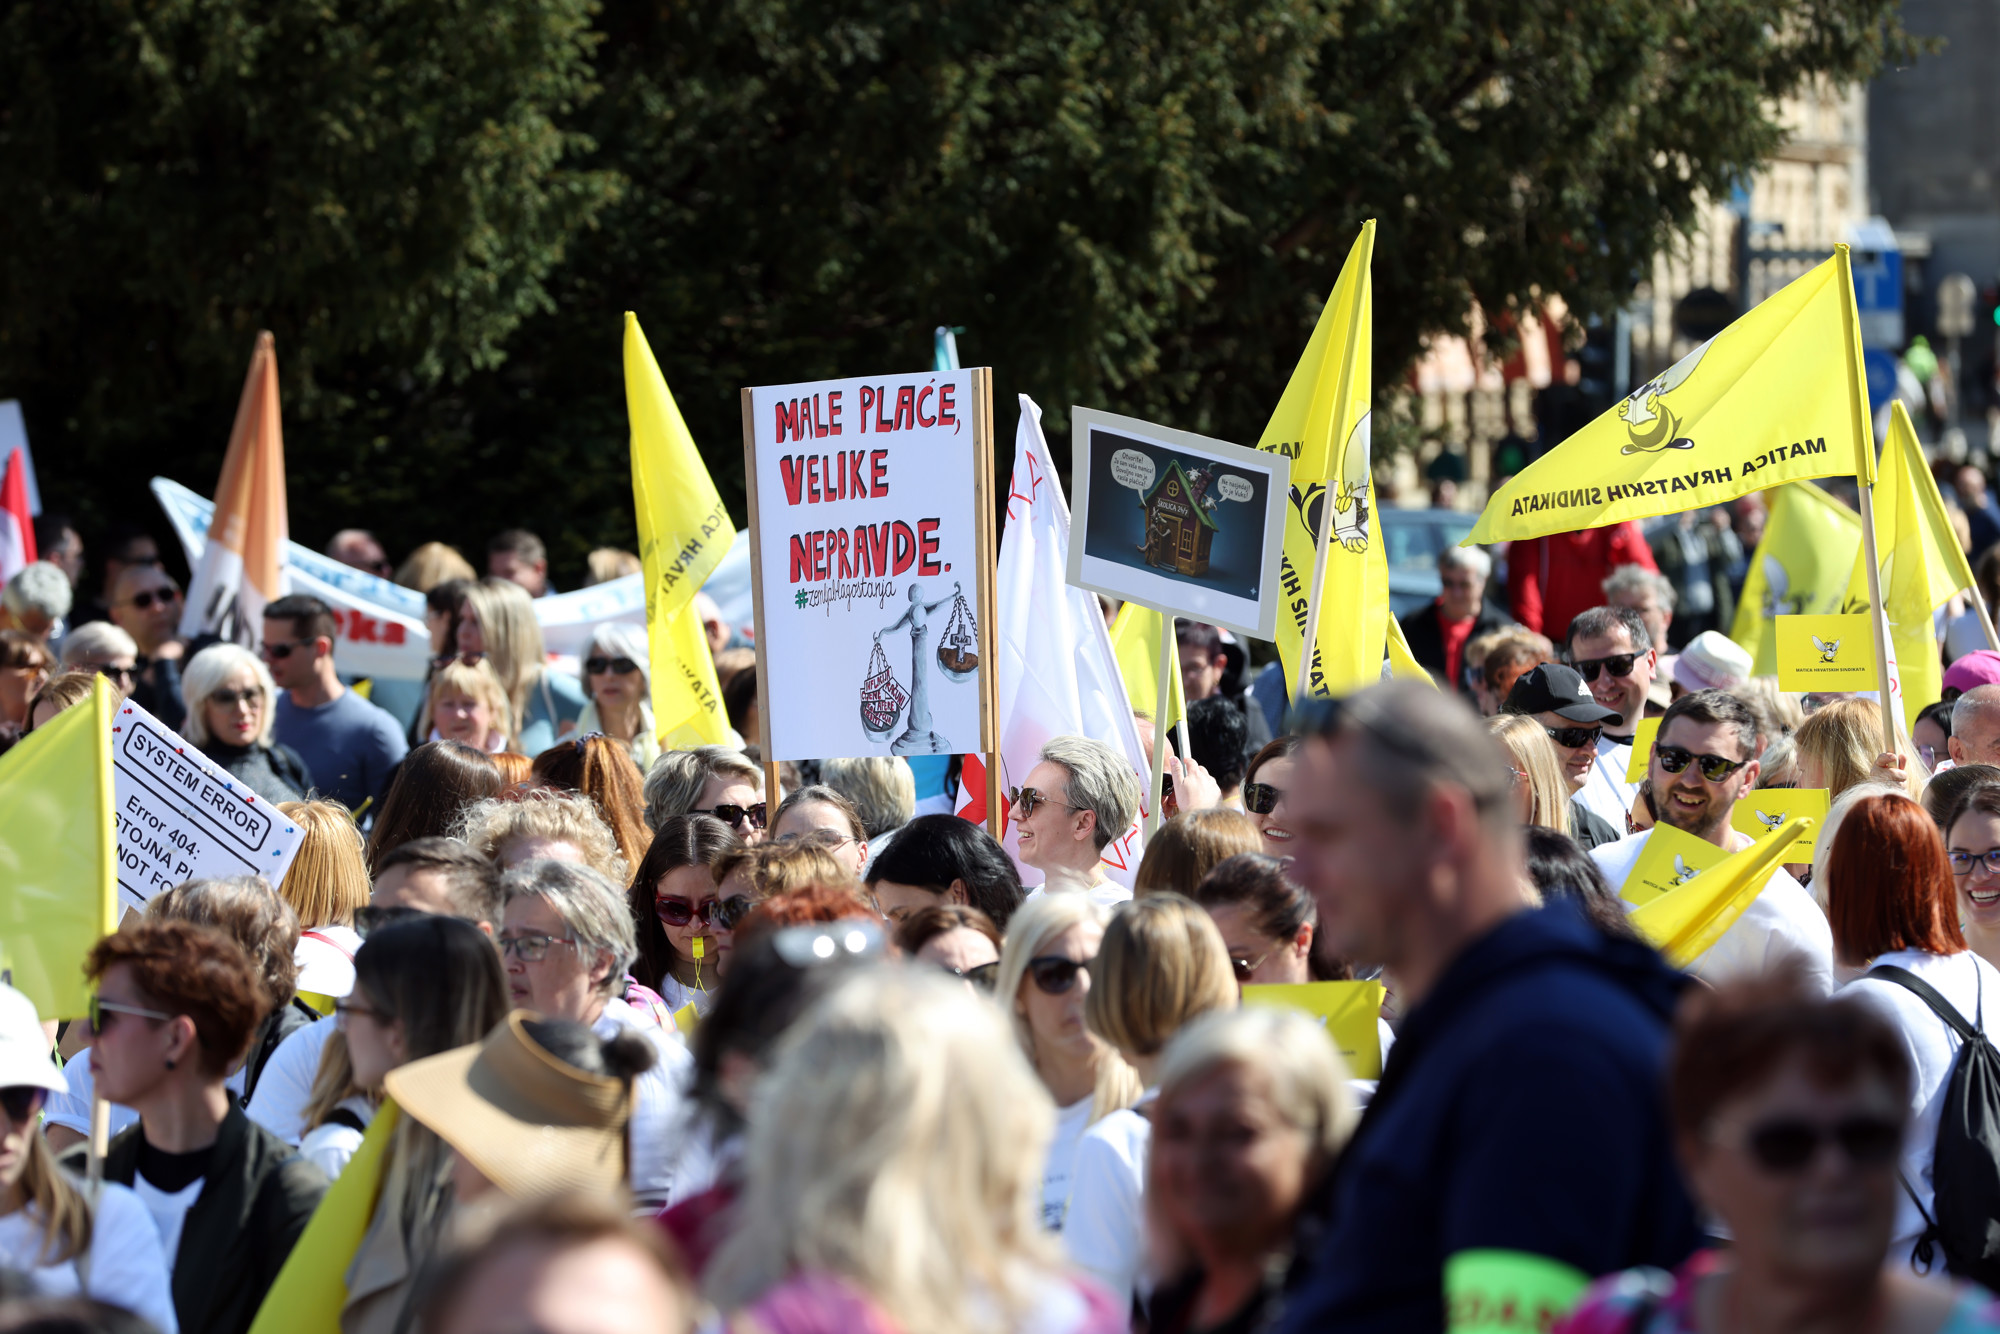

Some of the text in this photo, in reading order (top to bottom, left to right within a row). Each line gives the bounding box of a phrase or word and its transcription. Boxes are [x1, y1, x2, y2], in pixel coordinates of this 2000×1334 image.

[775, 378, 960, 443] MALE PLAĆE,
[780, 449, 889, 506] VELIKE
[790, 518, 951, 583] NEPRAVDE.
[1281, 550, 1302, 597] KIH
[134, 734, 260, 838] SYSTEM ERROR
[114, 811, 172, 869] STOJNA
[126, 794, 201, 860] Error 404:
[117, 844, 174, 892] NOT FO
